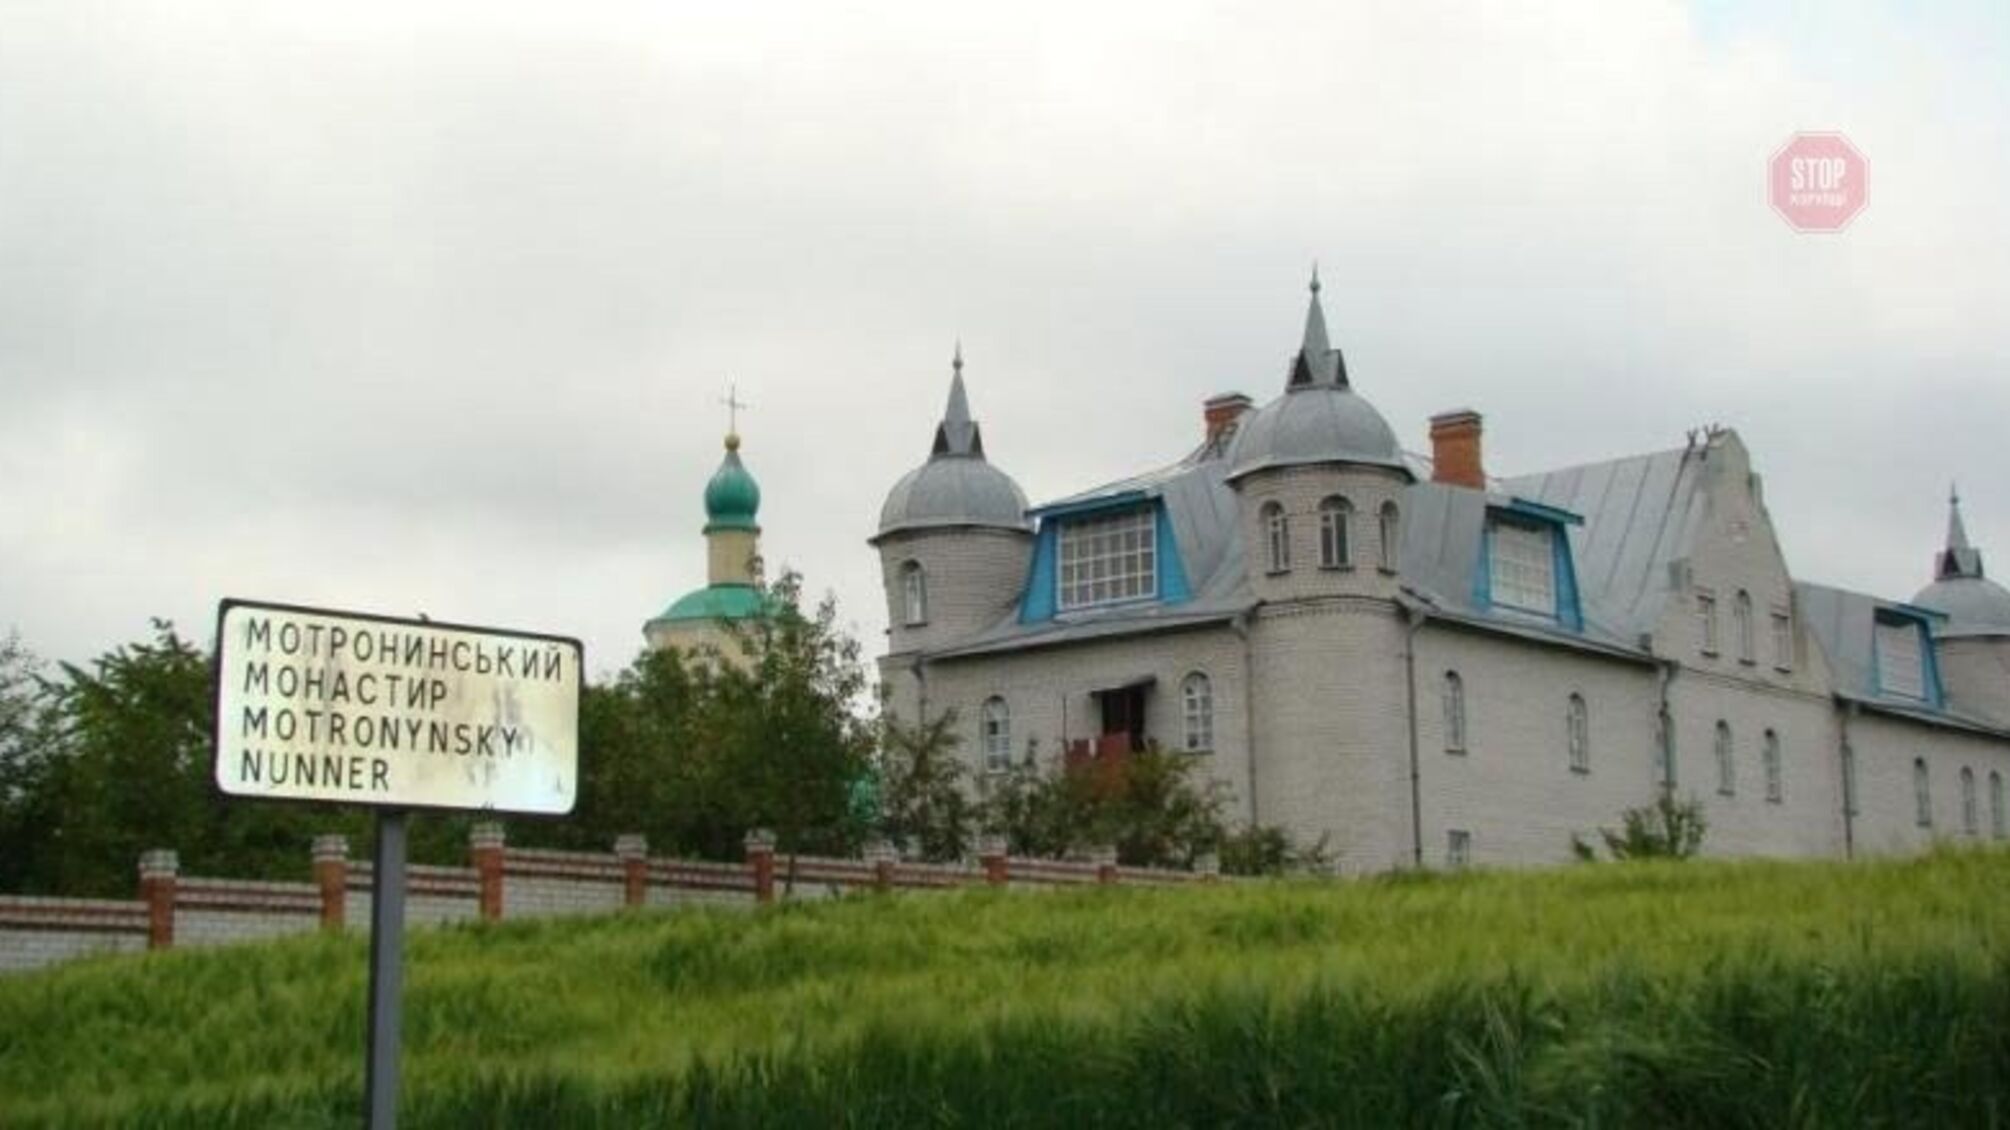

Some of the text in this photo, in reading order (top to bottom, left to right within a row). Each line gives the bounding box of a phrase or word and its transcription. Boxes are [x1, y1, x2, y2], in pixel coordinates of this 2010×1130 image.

[247, 617, 562, 682] МОТРОНИНСЬКИЙ
[244, 662, 447, 710] МОНАСТИР
[242, 706, 518, 760] MOTRONYNSKY
[241, 750, 390, 791] NUNNER
